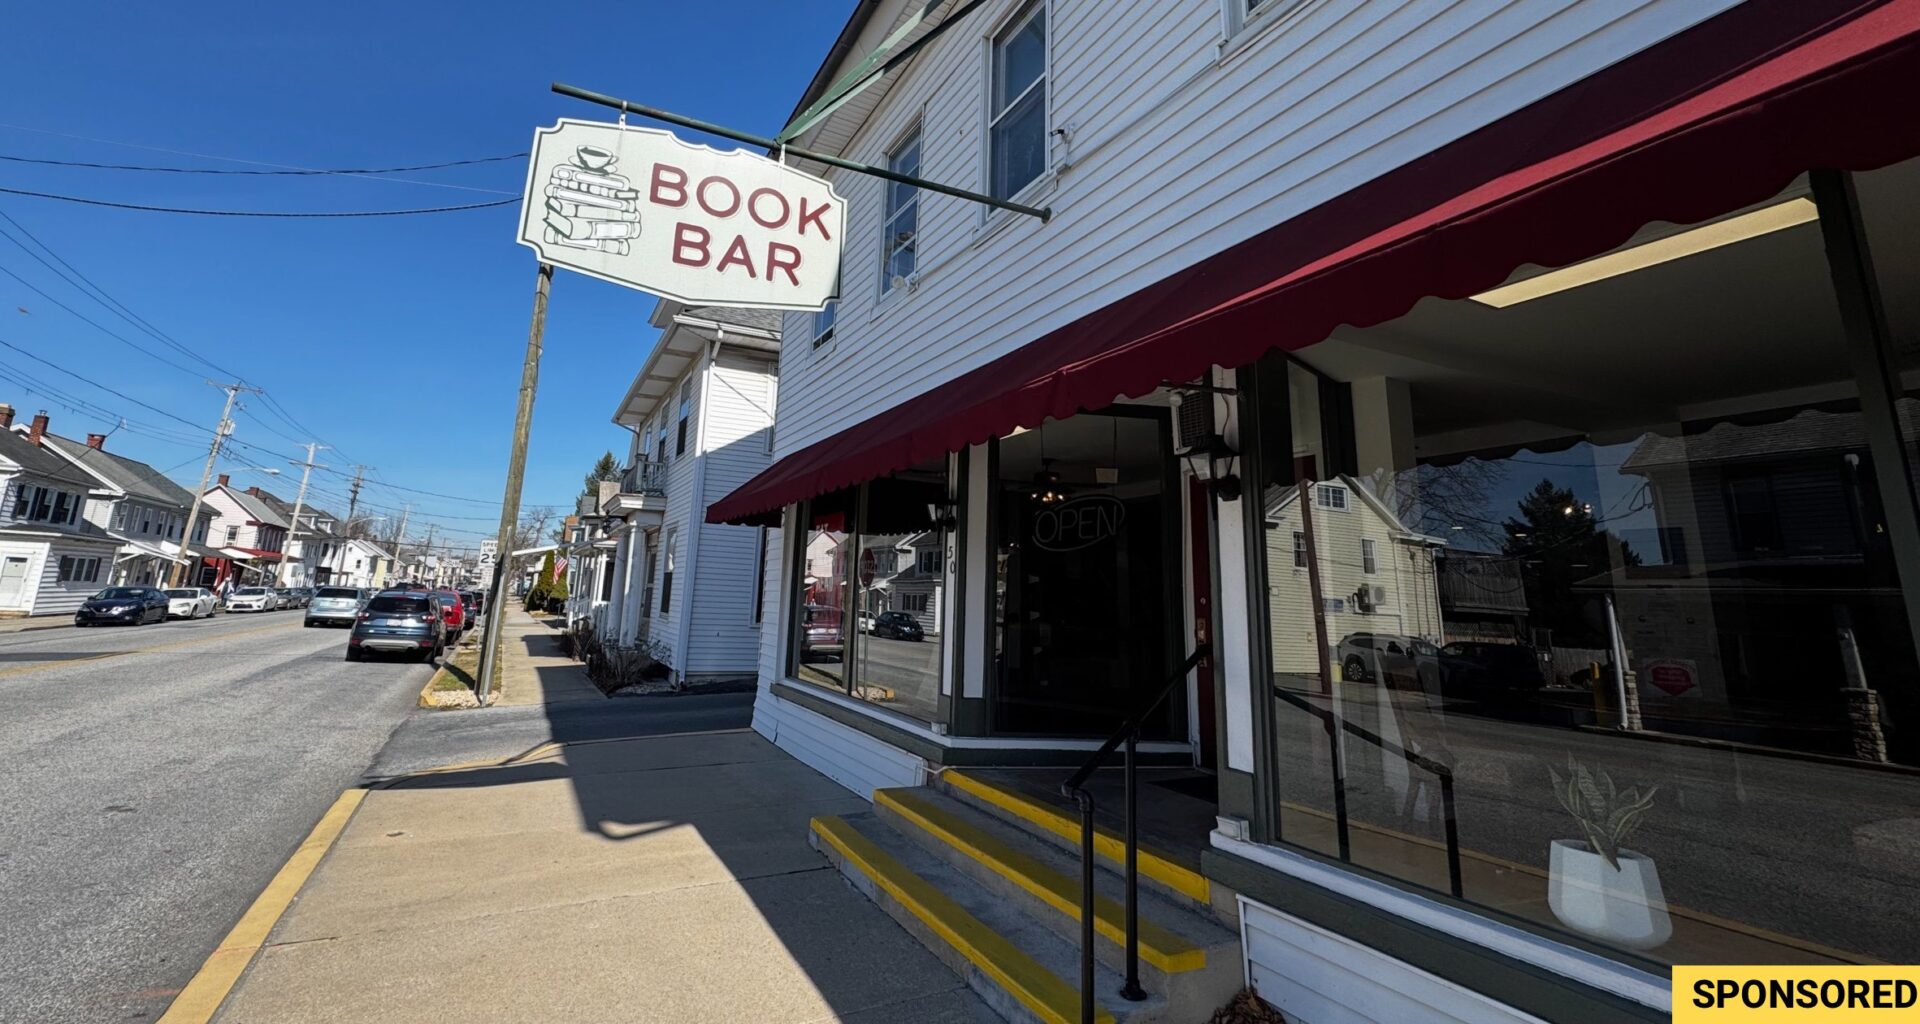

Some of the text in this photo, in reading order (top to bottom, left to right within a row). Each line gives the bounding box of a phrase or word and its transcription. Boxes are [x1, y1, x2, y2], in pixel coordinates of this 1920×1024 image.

[650, 162, 831, 241] BOOK
[672, 222, 802, 287] BAR
[1035, 504, 1117, 542] OPEN
[947, 545, 956, 574] 50
